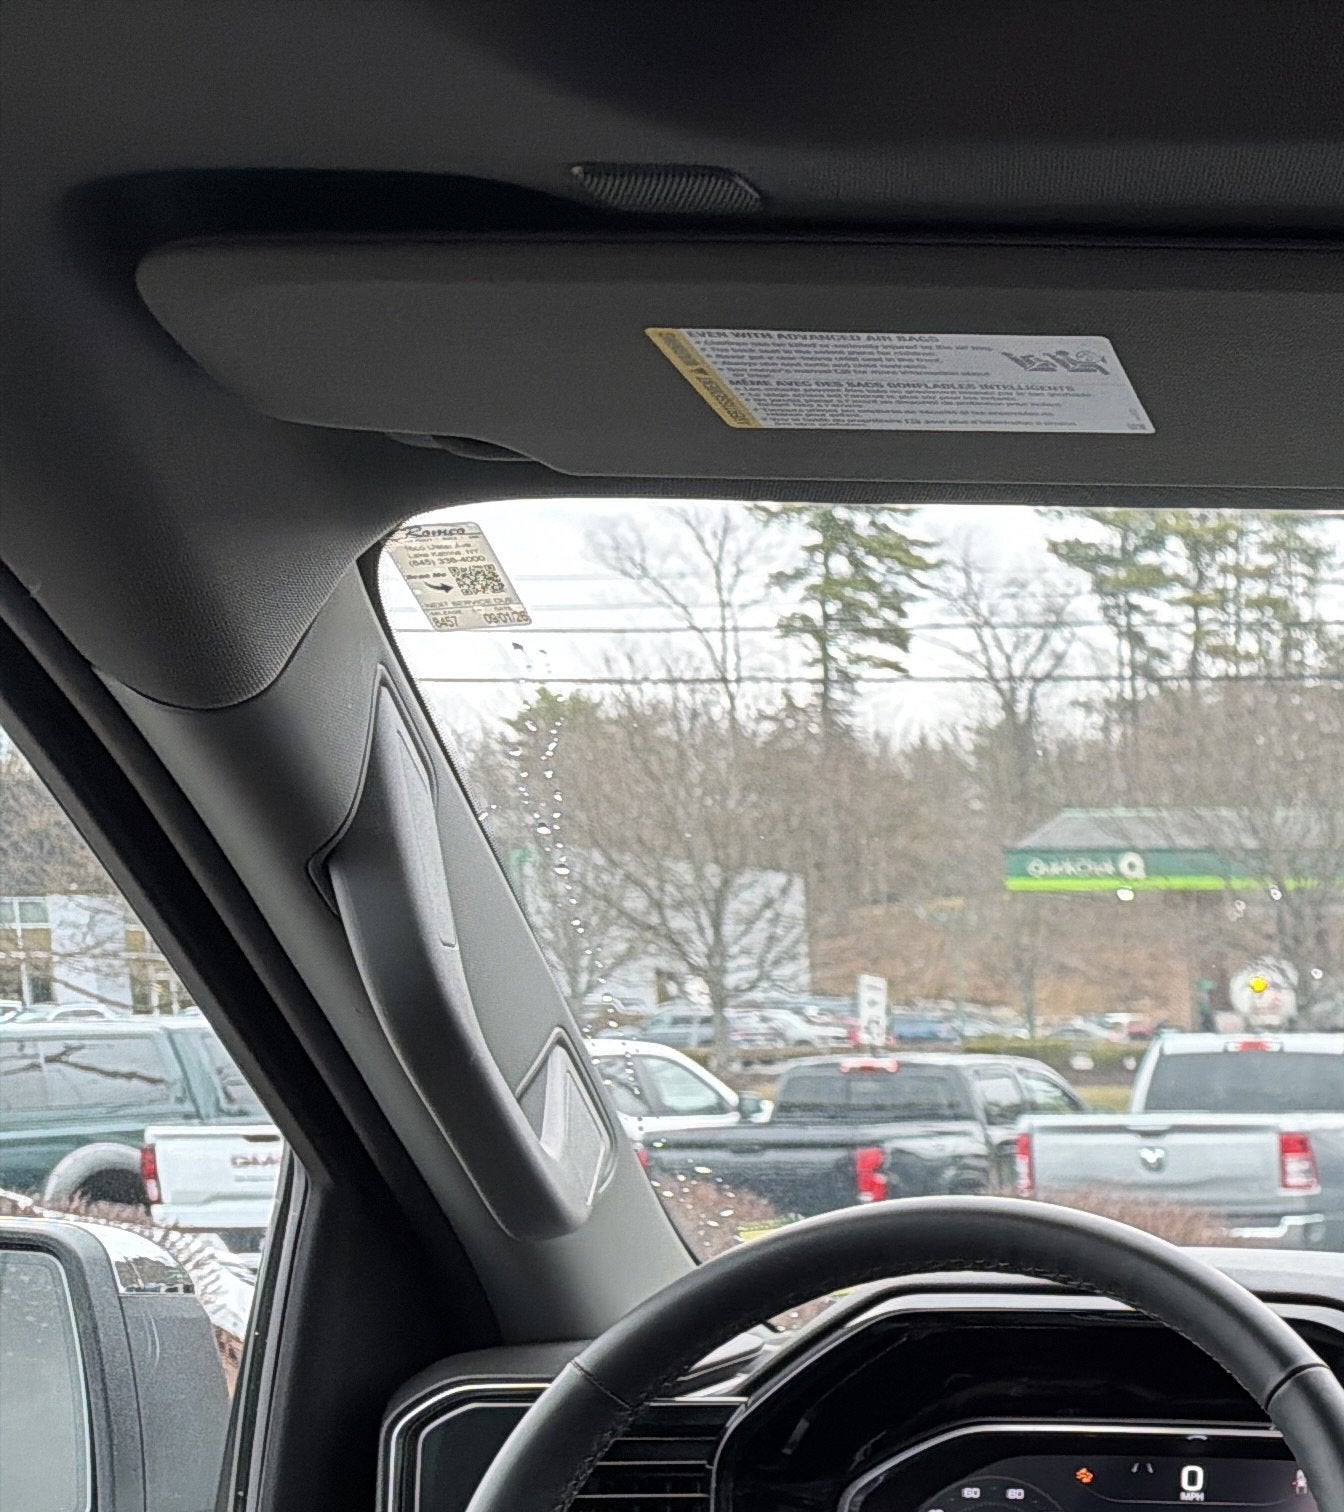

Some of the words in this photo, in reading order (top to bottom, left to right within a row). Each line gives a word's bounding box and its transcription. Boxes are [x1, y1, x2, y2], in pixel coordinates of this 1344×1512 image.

[731, 332, 772, 340] WITH
[1181, 1465, 1204, 1491] 0
[961, 1487, 981, 1499] 60
[1180, 1491, 1205, 1502] MPH
